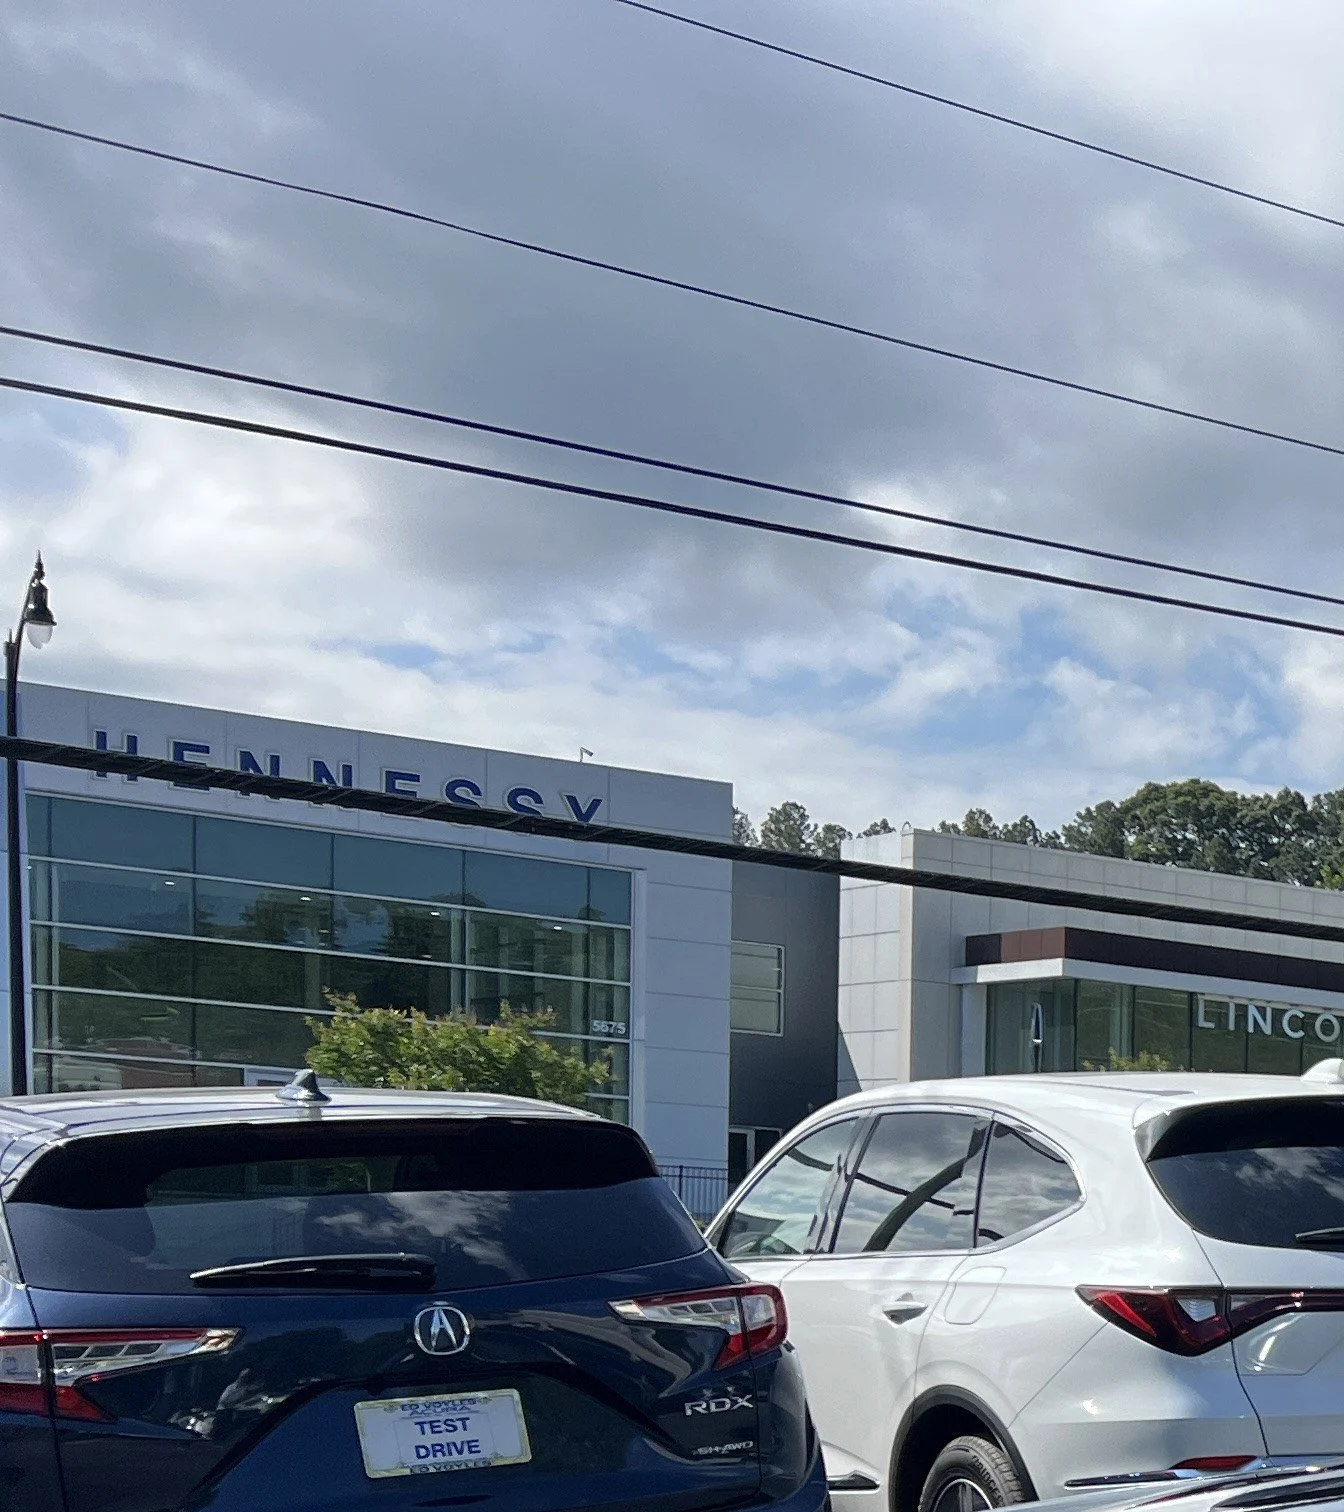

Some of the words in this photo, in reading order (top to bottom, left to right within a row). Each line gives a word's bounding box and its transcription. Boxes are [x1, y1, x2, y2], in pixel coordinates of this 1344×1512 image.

[96, 730, 602, 828] HENNESSY
[684, 1394, 754, 1416] RDX
[414, 1417, 471, 1435] TEST
[414, 1439, 482, 1460] DRIVE
